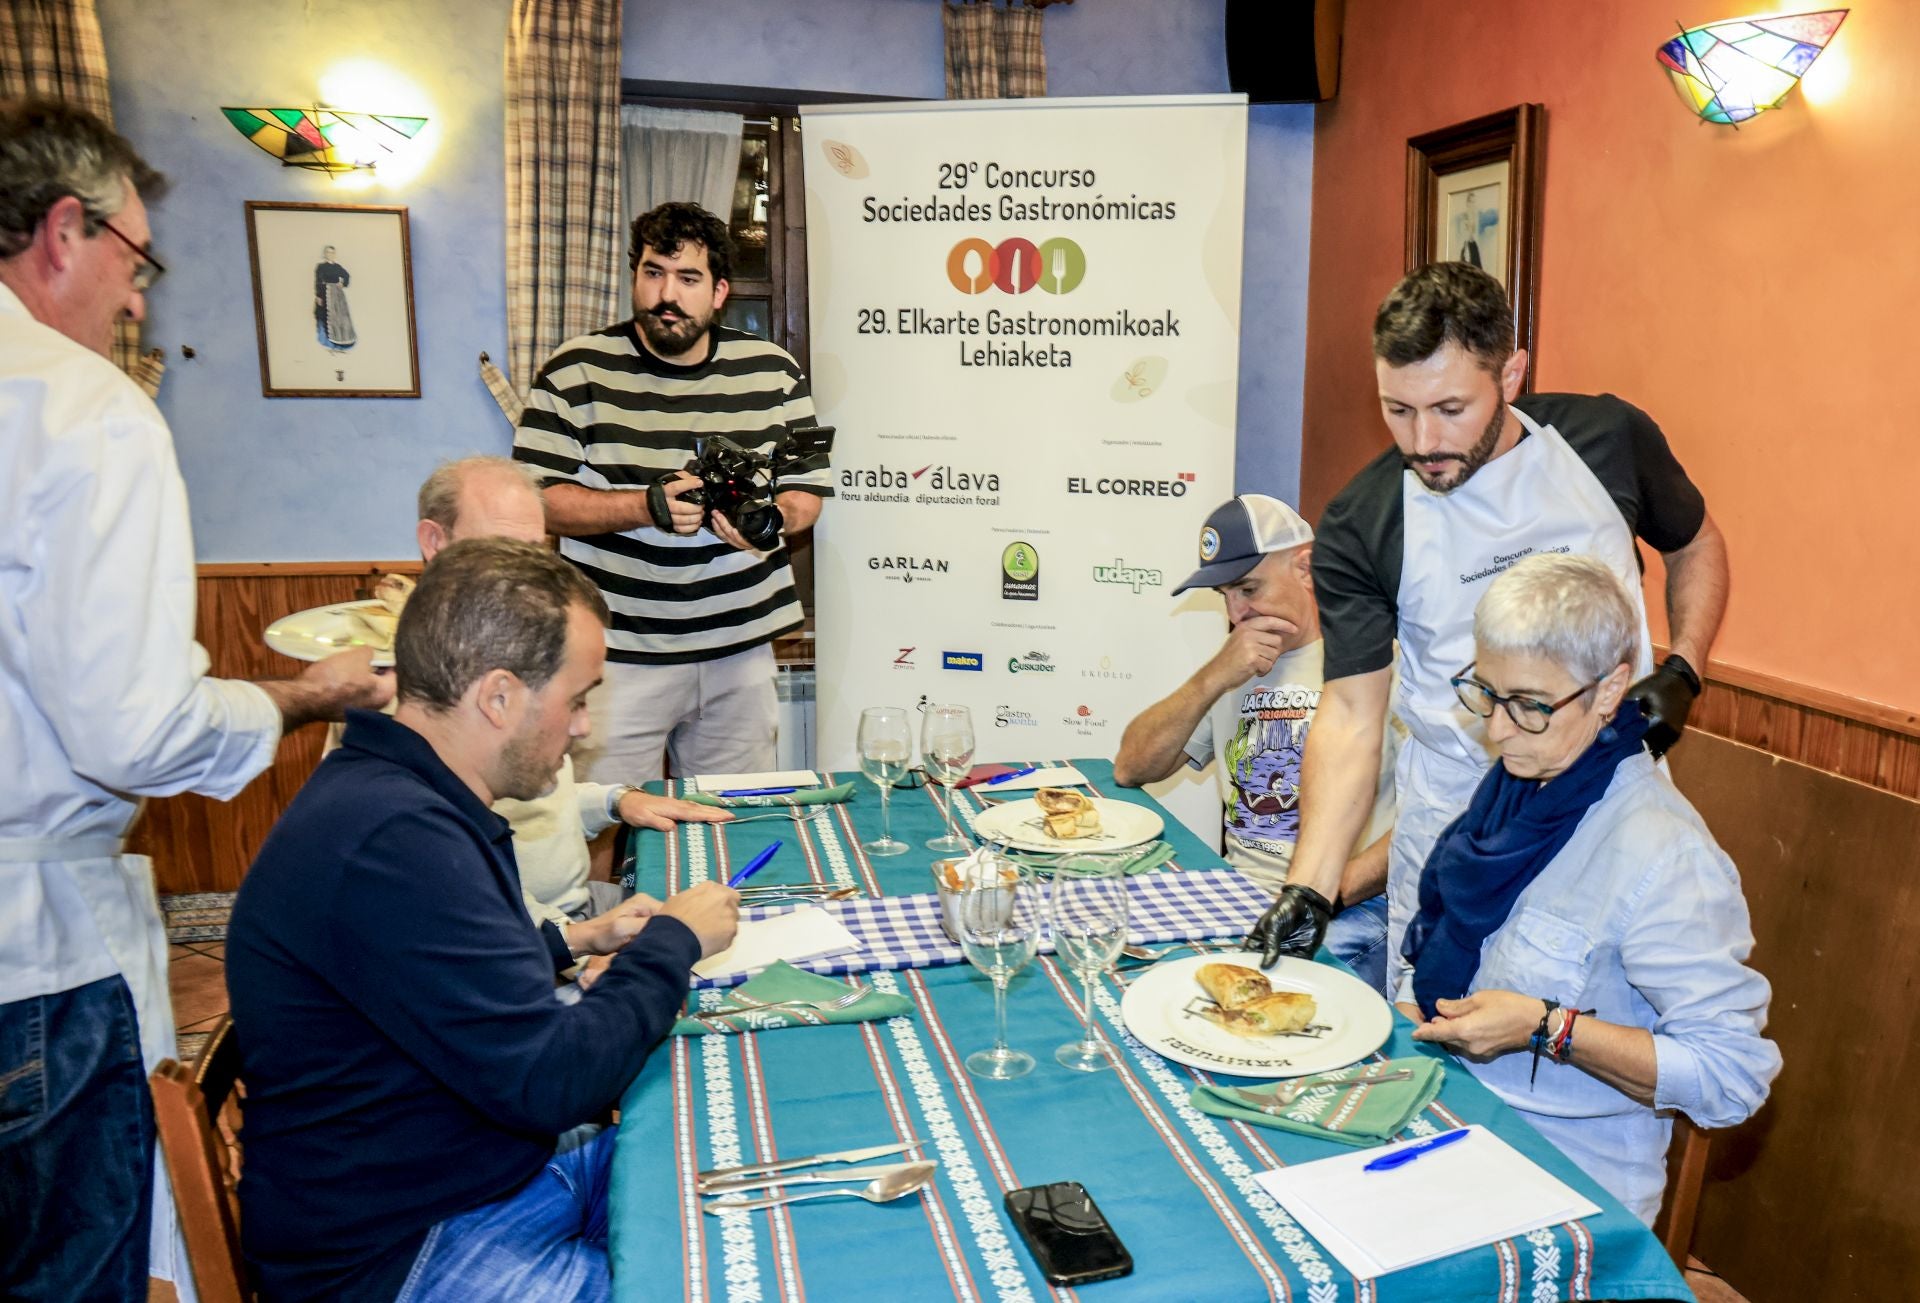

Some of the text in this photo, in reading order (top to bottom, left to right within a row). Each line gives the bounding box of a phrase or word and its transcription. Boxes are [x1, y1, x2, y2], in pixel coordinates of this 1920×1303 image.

[986, 162, 1096, 189] Concurso
[863, 193, 1176, 222] Sociedades Gastronómicas
[858, 308, 1180, 337] 29. Elkarte Gastronomikoak
[960, 340, 1072, 367] Lehiaketa
[841, 464, 1000, 491] araba álava
[1068, 477, 1187, 497] EL CORREO
[841, 491, 1000, 506] foru aldundia diputación foral
[868, 556, 949, 573] GARLAN
[1493, 546, 1533, 564] Concurso
[1093, 558, 1162, 594] udapa
[1460, 564, 1507, 584] Sociedades
[946, 655, 979, 667] makro
[1063, 716, 1082, 725] Slow
[1257, 709, 1307, 721] ORIGINALS
